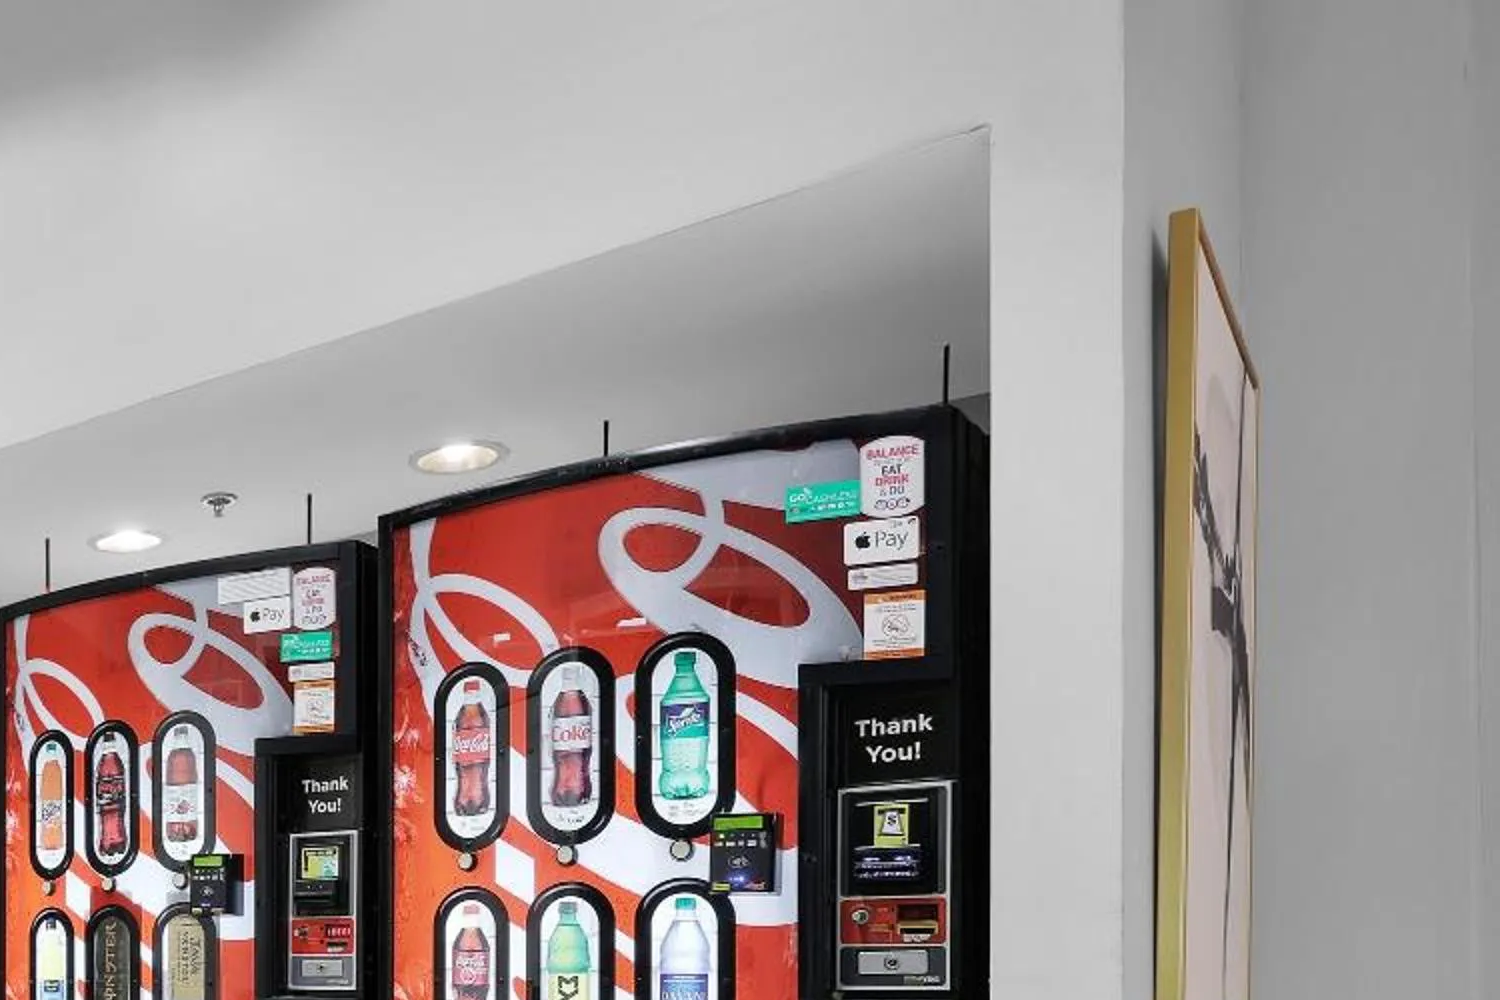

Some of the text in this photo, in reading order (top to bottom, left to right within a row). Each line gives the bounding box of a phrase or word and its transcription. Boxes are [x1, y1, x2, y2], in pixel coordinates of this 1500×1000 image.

[867, 444, 919, 459] BALANCE
[881, 464, 902, 476] EAT
[875, 474, 909, 487] DRINK
[875, 531, 909, 550] Pay
[263, 608, 285, 622] Pay
[854, 713, 933, 738] Thank
[865, 742, 921, 763] You!
[302, 776, 349, 794] Thank
[308, 798, 341, 814] You!
